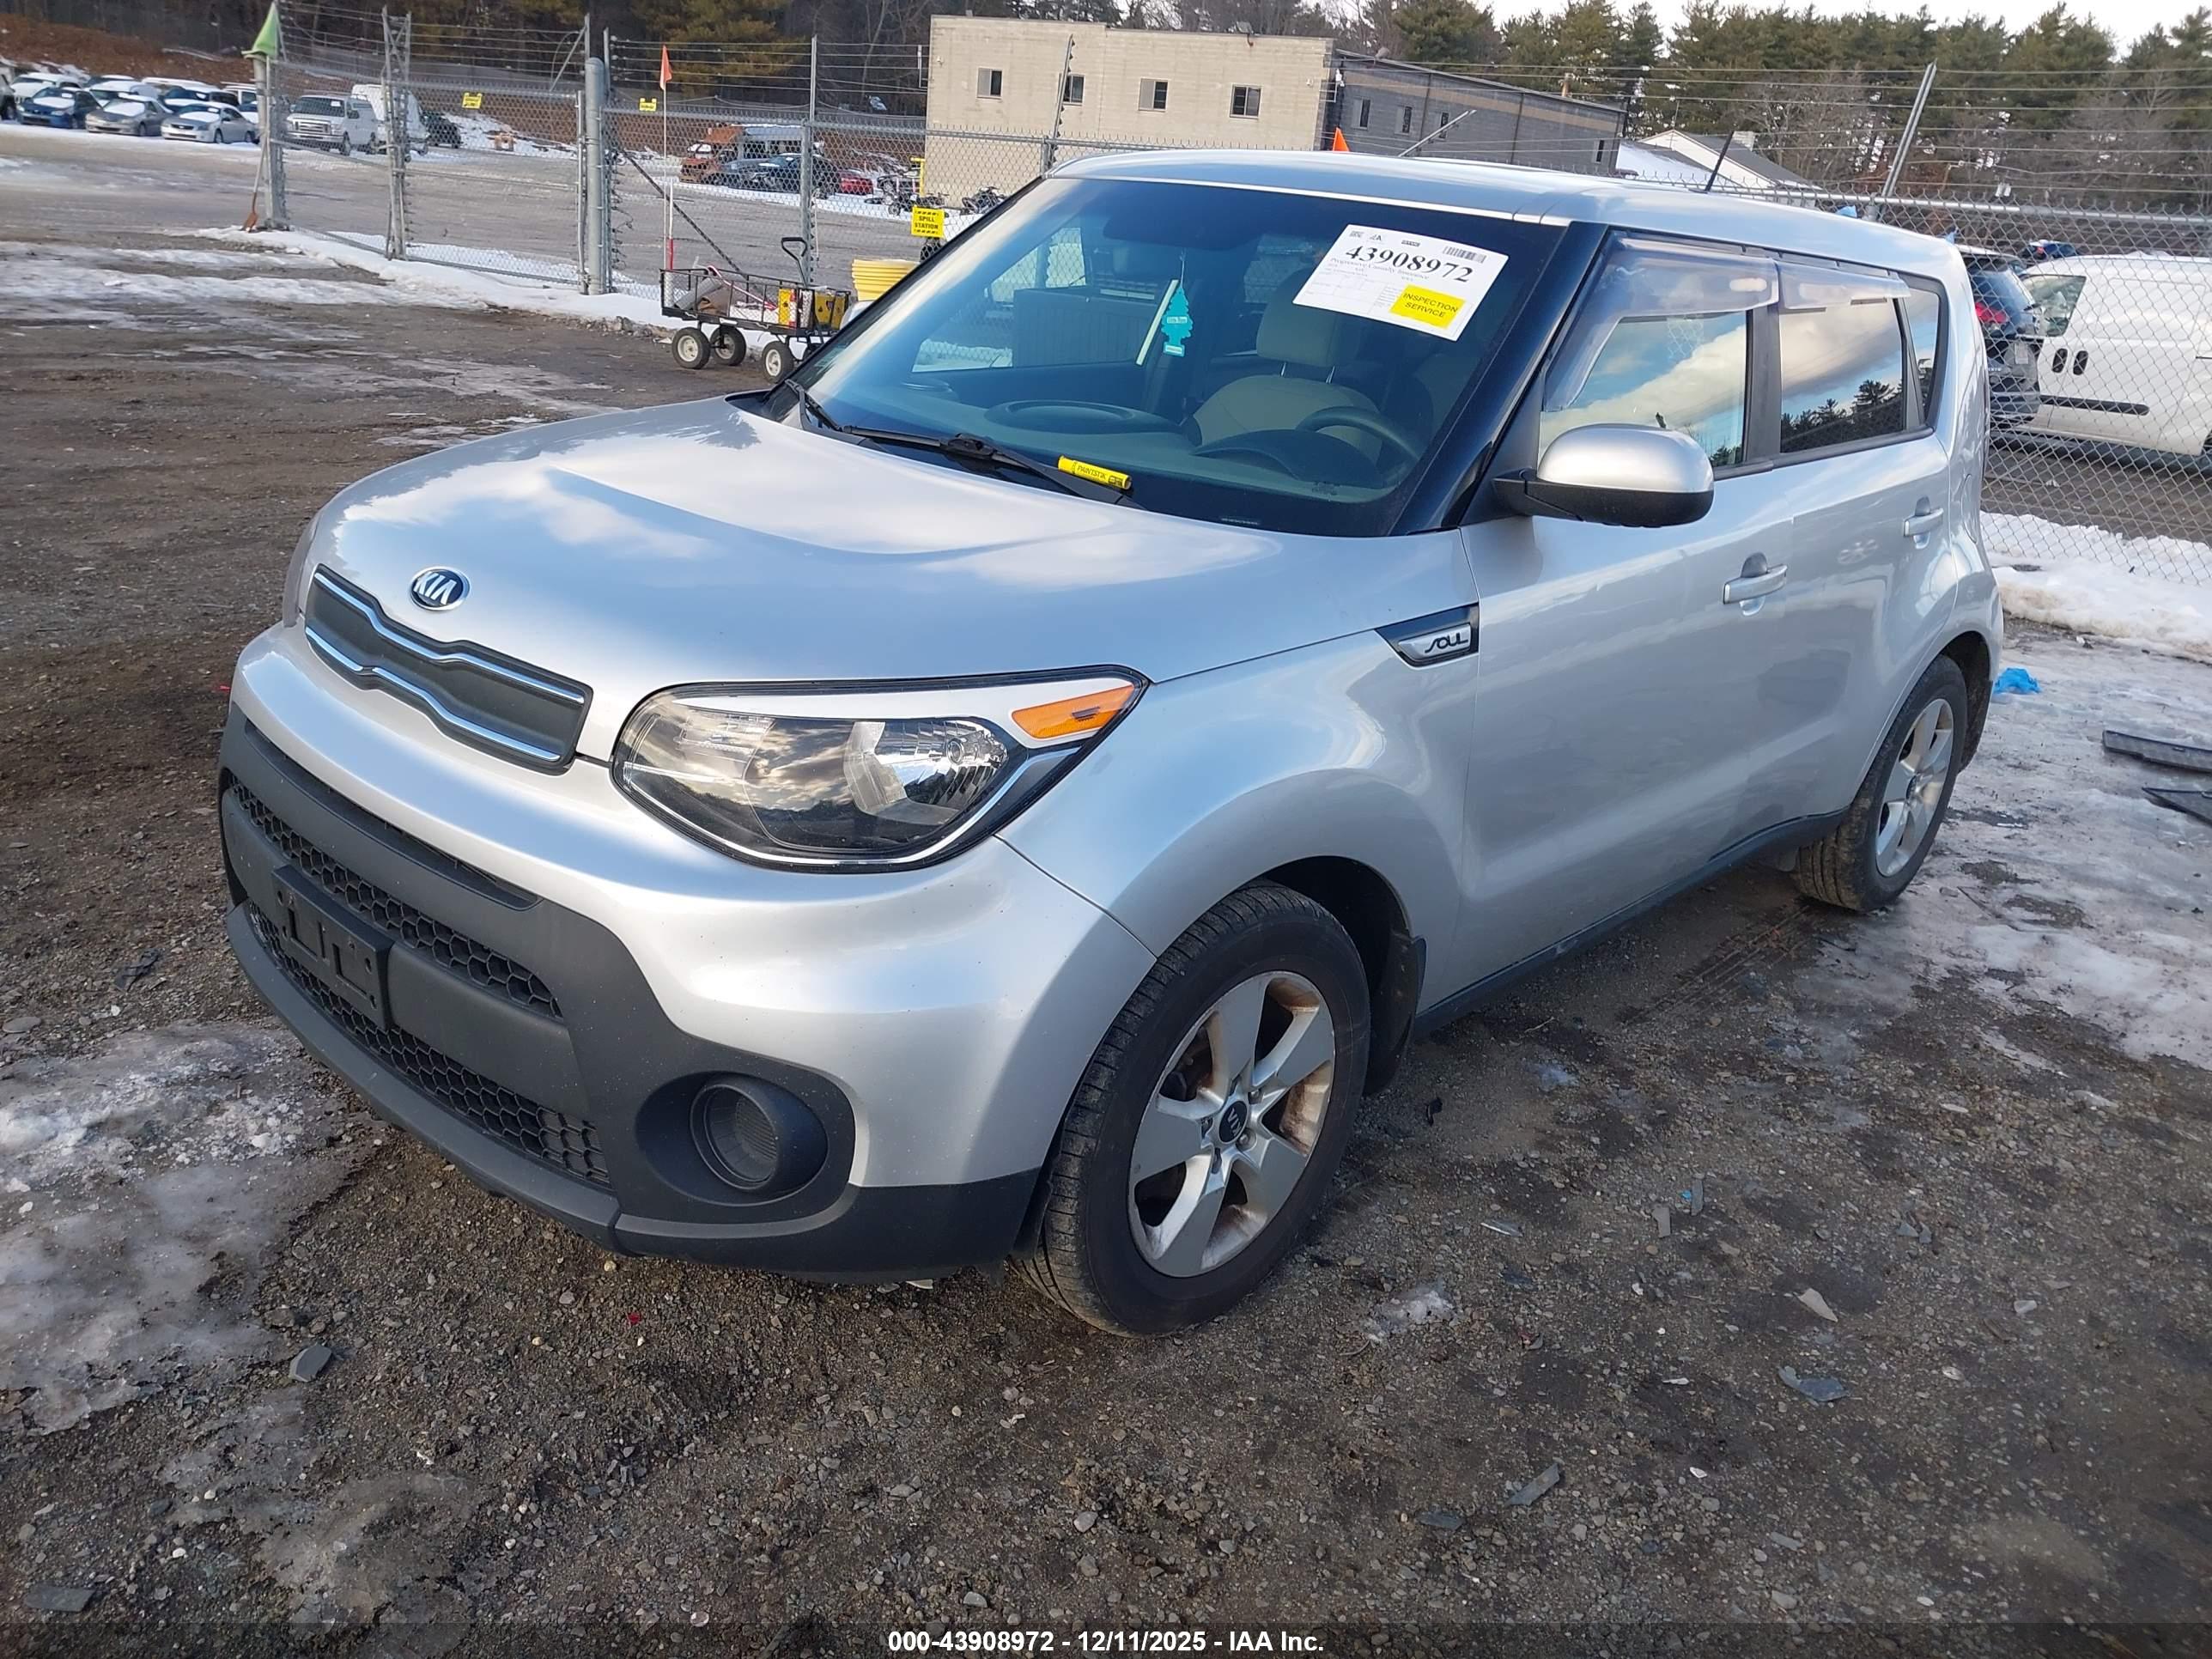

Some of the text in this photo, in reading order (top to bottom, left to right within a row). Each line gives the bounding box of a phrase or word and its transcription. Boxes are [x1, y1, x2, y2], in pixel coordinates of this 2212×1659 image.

[1346, 246, 1474, 283] 43908972
[1402, 293, 1459, 313] INSPECTION
[1404, 302, 1447, 319] SERVICE
[413, 571, 457, 605] KIA
[1425, 632, 1469, 653] SOUL
